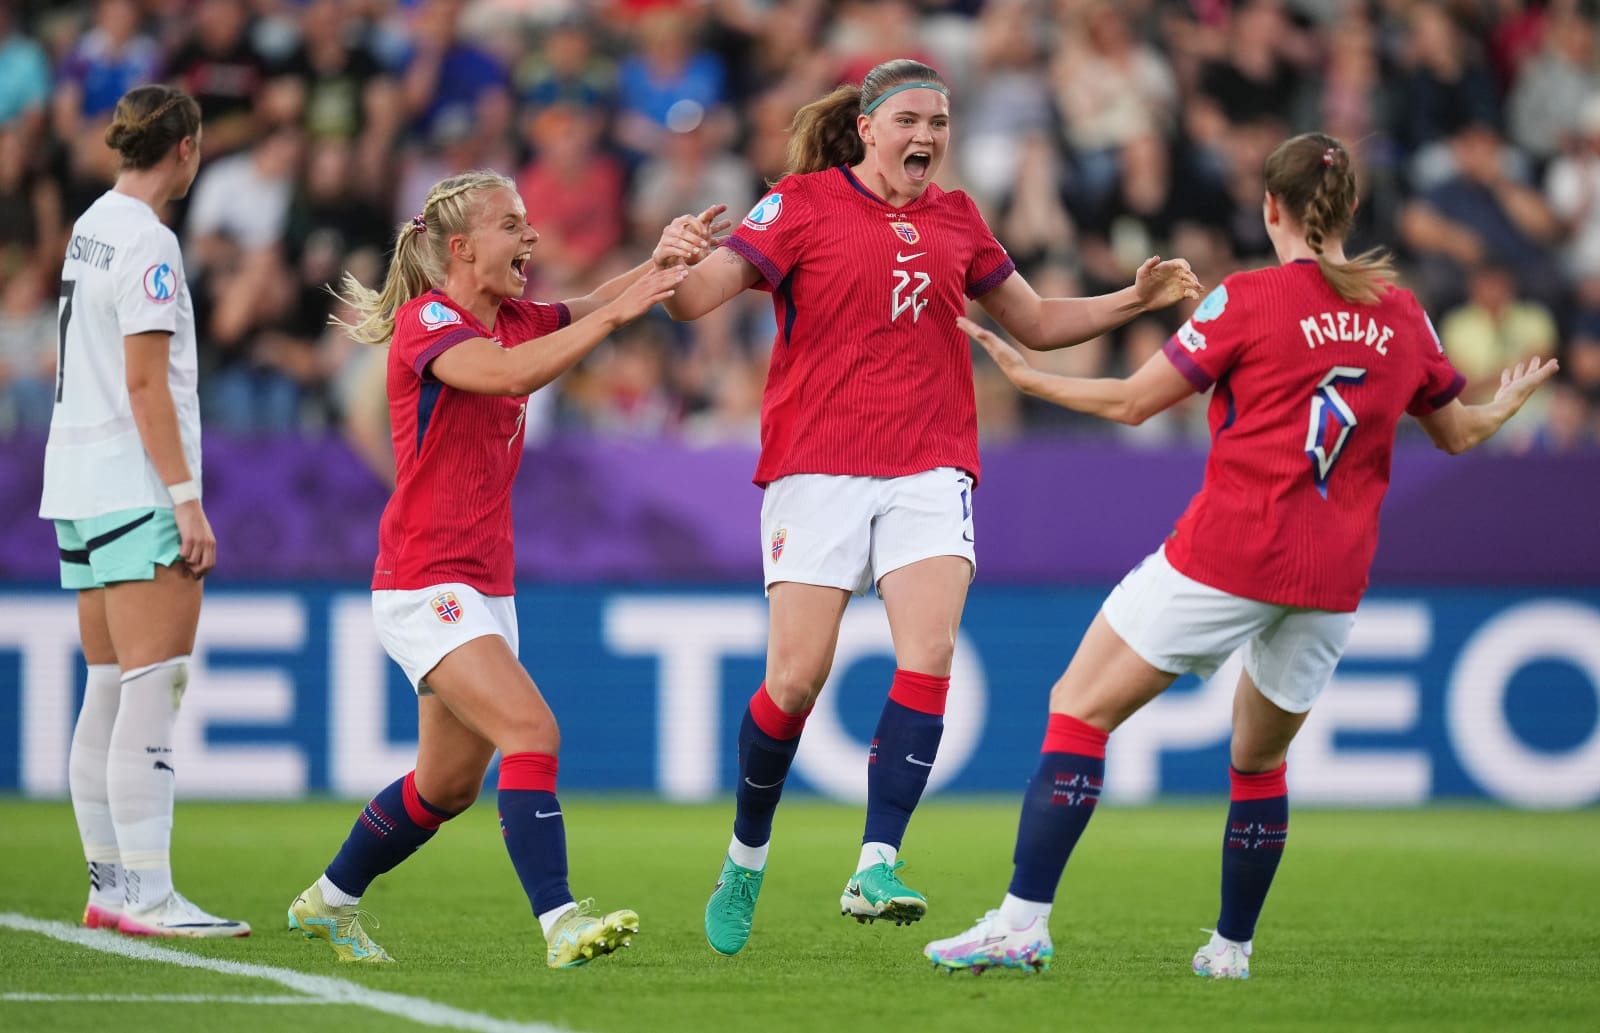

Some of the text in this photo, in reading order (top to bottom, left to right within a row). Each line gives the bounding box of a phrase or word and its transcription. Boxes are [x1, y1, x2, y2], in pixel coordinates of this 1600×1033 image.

[892, 269, 931, 323] 22
[1300, 311, 1395, 357] MJELDE
[1305, 365, 1367, 501] 6
[602, 596, 987, 806] TO
